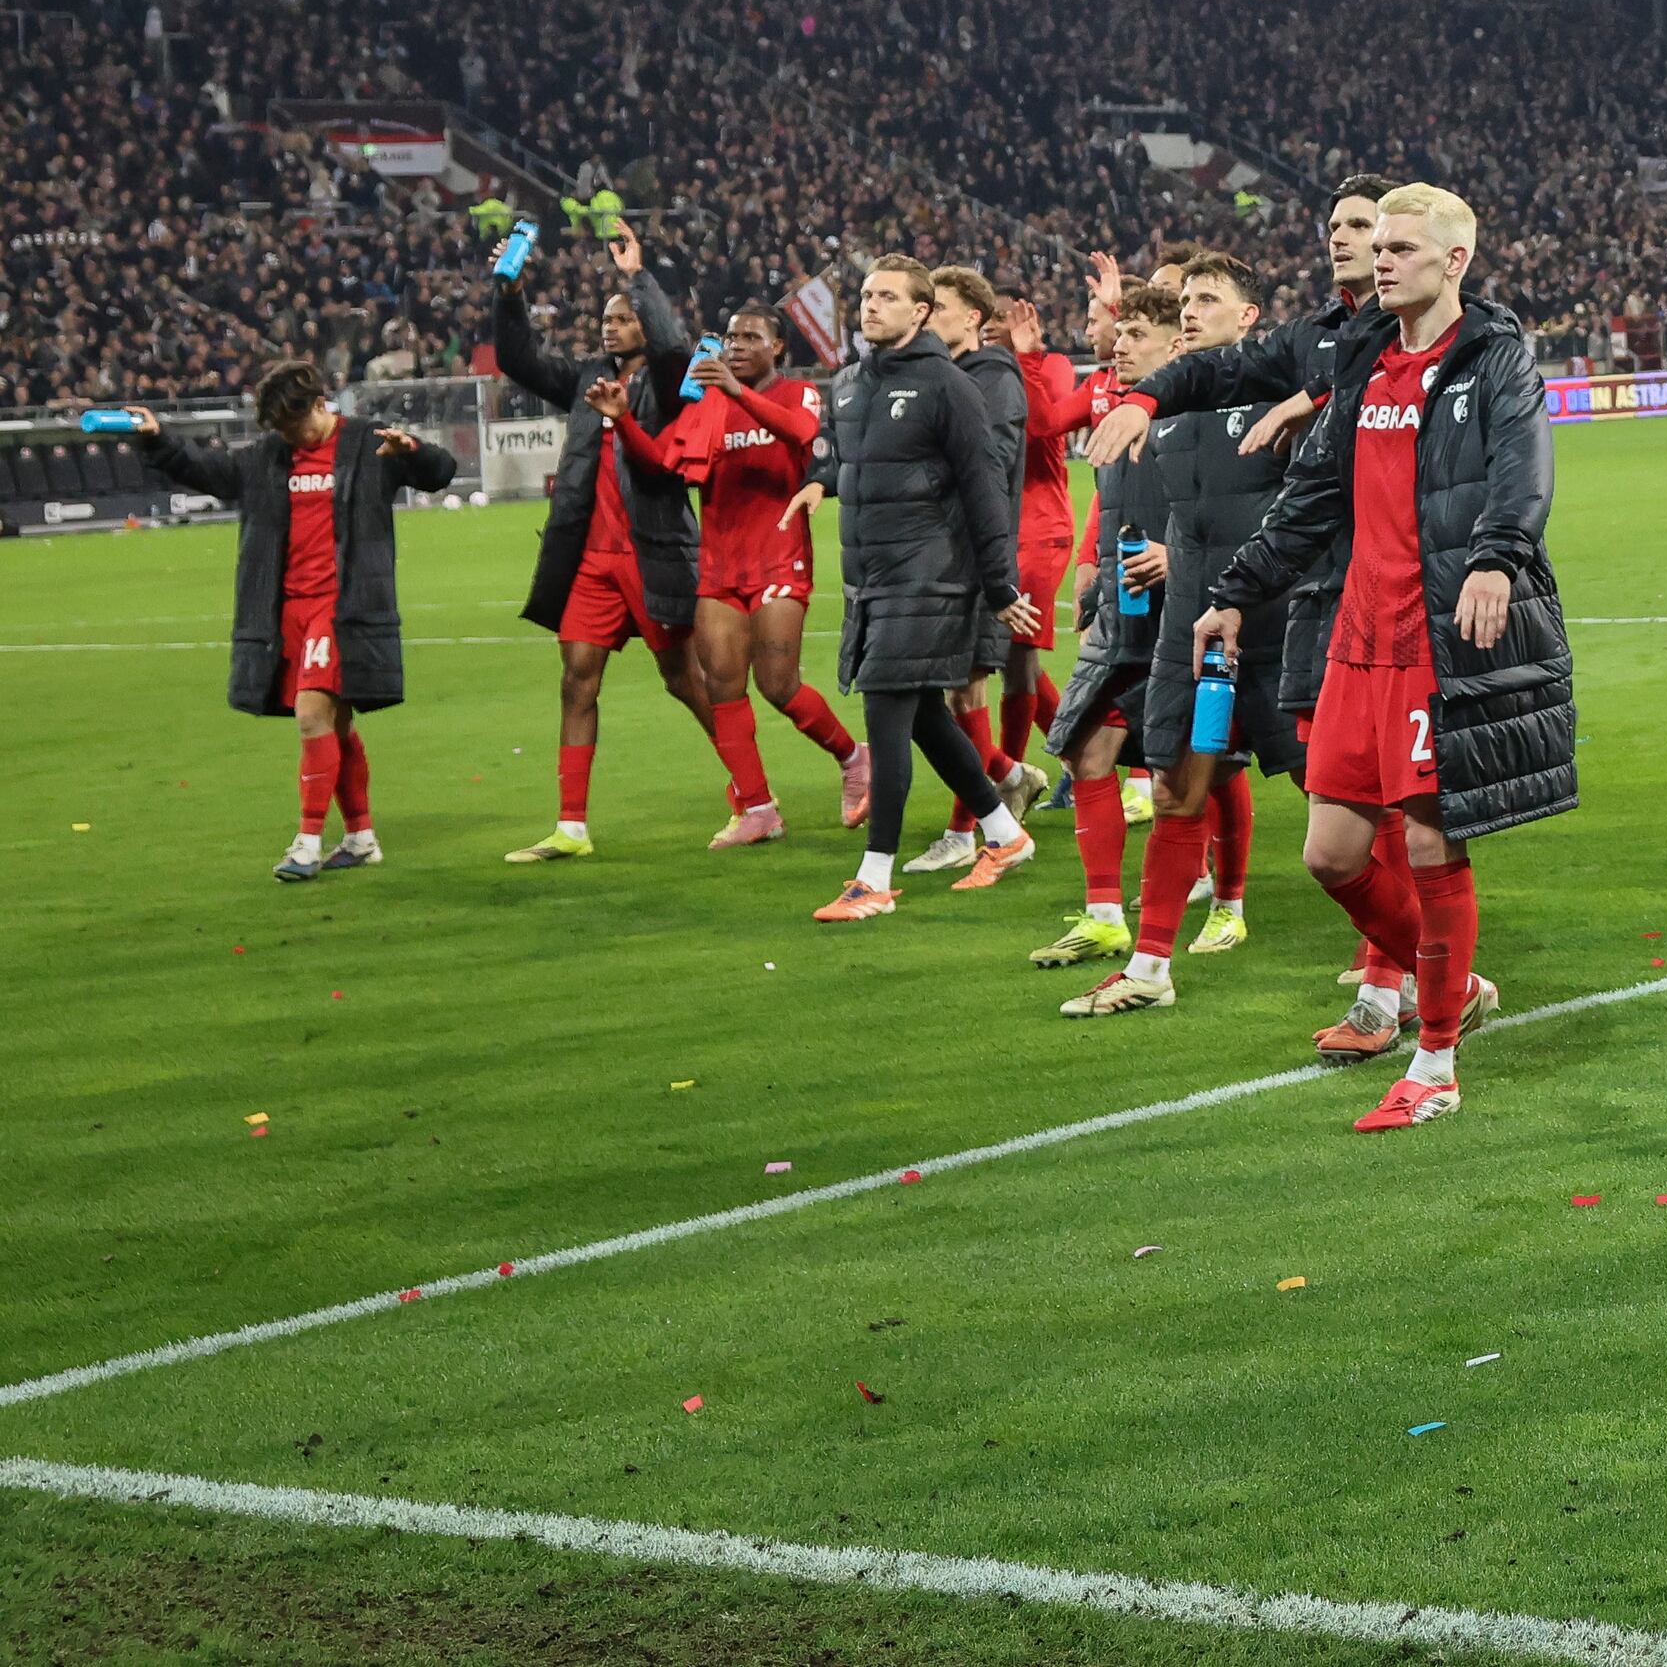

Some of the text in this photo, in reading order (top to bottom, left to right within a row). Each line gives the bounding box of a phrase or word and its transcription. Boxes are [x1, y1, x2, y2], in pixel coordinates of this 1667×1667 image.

[723, 427, 776, 451] BRAD
[287, 472, 336, 493] OBRA
[302, 636, 330, 669] 14
